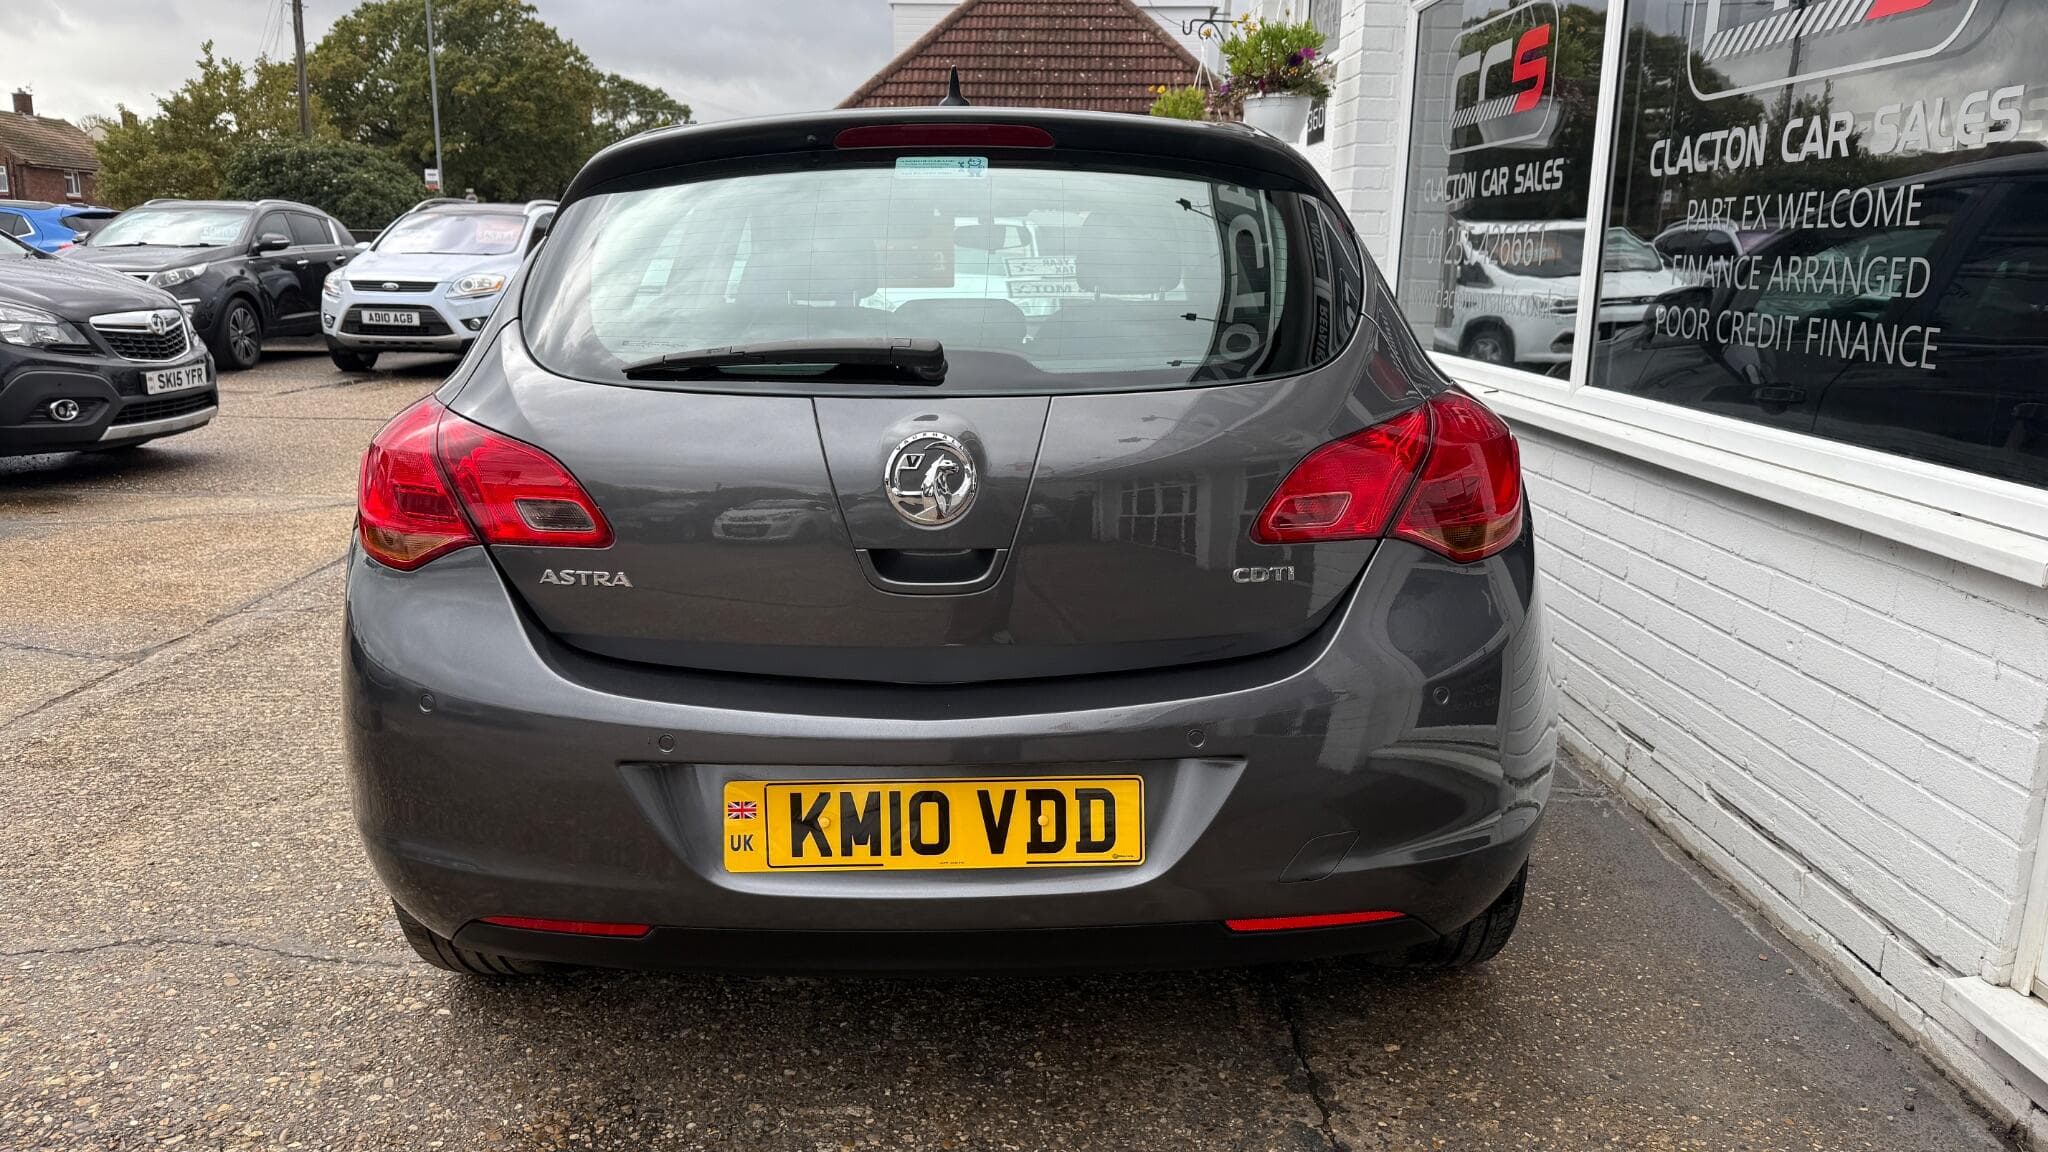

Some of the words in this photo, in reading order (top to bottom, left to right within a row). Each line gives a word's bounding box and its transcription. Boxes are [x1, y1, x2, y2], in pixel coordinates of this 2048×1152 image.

[1649, 122, 1768, 177] CLACTON
[1781, 110, 1855, 163] CAR
[1869, 84, 2025, 156] SALES
[1424, 171, 1477, 203] CLACTON
[1481, 166, 1509, 197] CAR
[1514, 158, 1565, 194] SALES
[1685, 196, 1738, 232] PART
[1741, 194, 1772, 230] EX
[1778, 183, 1926, 230] WELCOME
[1671, 254, 1763, 291] FINANCE
[1767, 255, 1931, 299] ARRANGED
[1655, 304, 1710, 342] POOR
[1716, 309, 1799, 352] CREDIT
[1804, 317, 1942, 370] FINANCE
[157, 371, 183, 389] SK15
[184, 367, 203, 385] YFR
[539, 569, 634, 588] ASTRA
[730, 833, 754, 852] UK
[789, 791, 951, 858] KM10
[976, 788, 1117, 855] VDD
